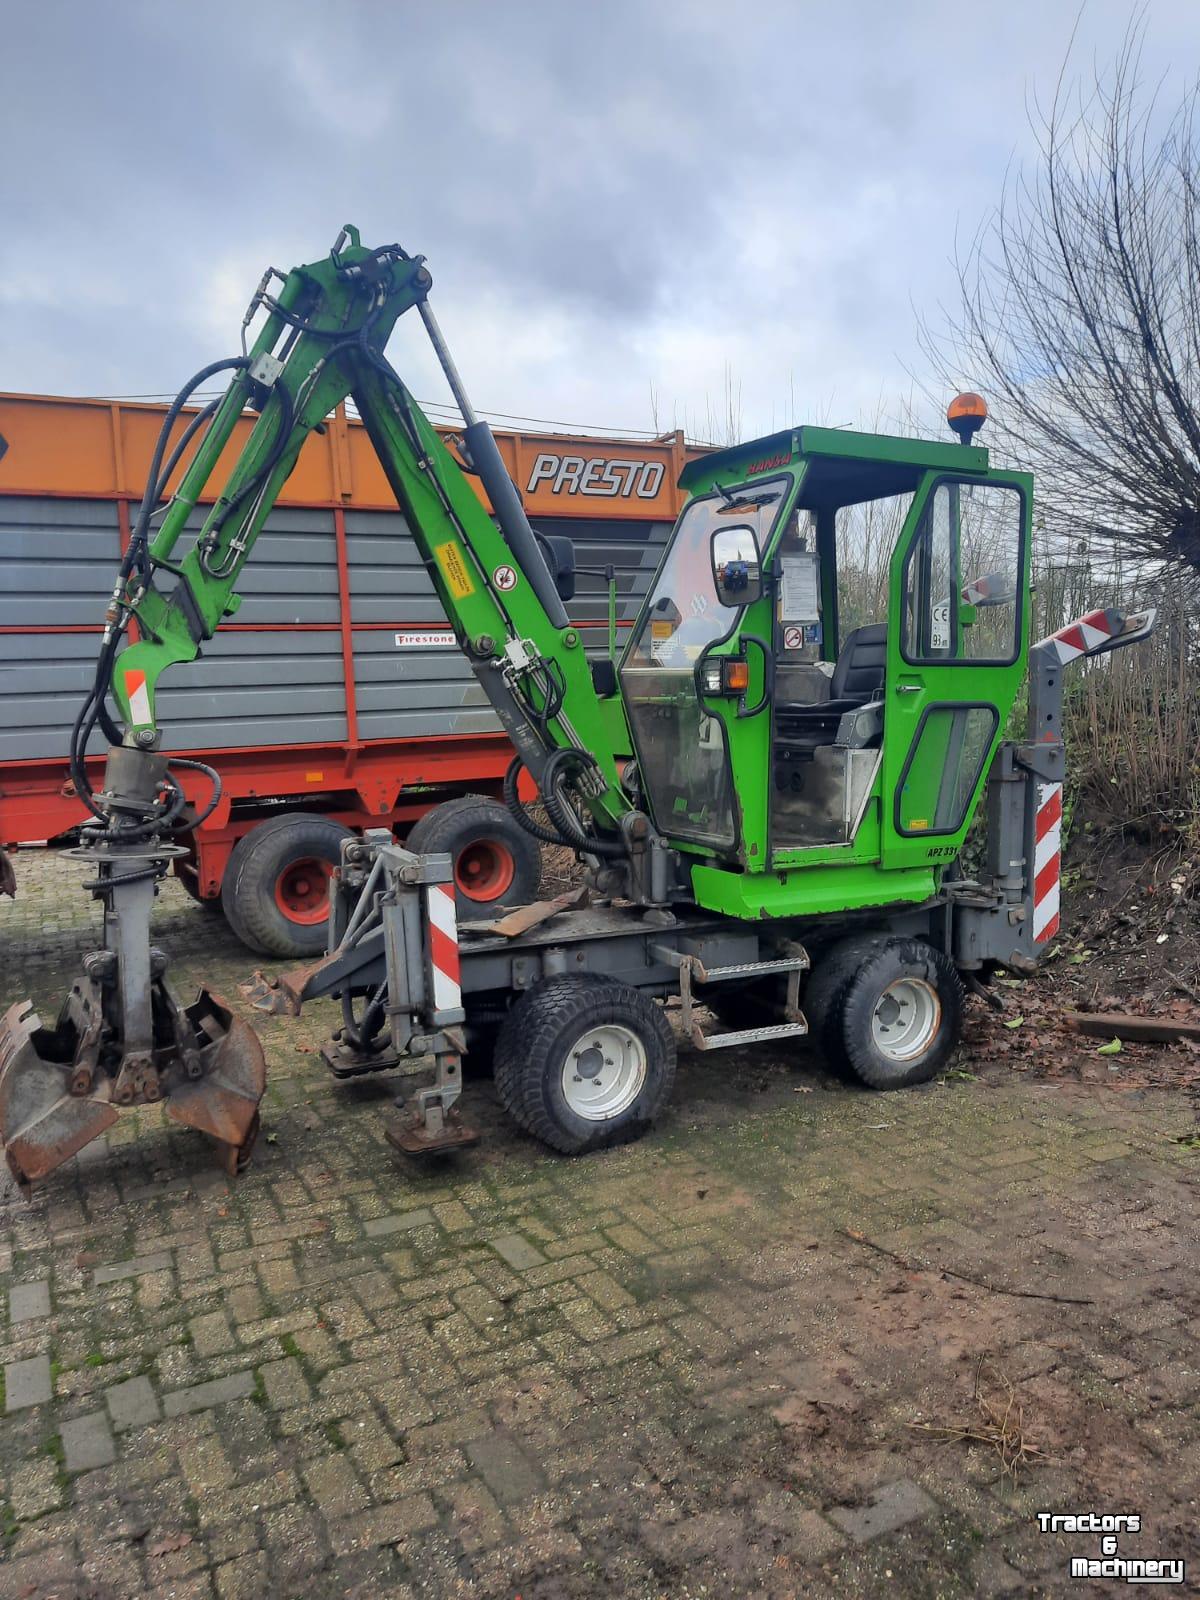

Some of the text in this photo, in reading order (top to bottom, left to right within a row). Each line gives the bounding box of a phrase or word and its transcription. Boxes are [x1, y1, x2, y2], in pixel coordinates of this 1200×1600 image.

[526, 453, 666, 499] PRESTO
[933, 608, 948, 622] CE
[397, 635, 454, 645] Firestone
[927, 846, 958, 858] APZ 331
